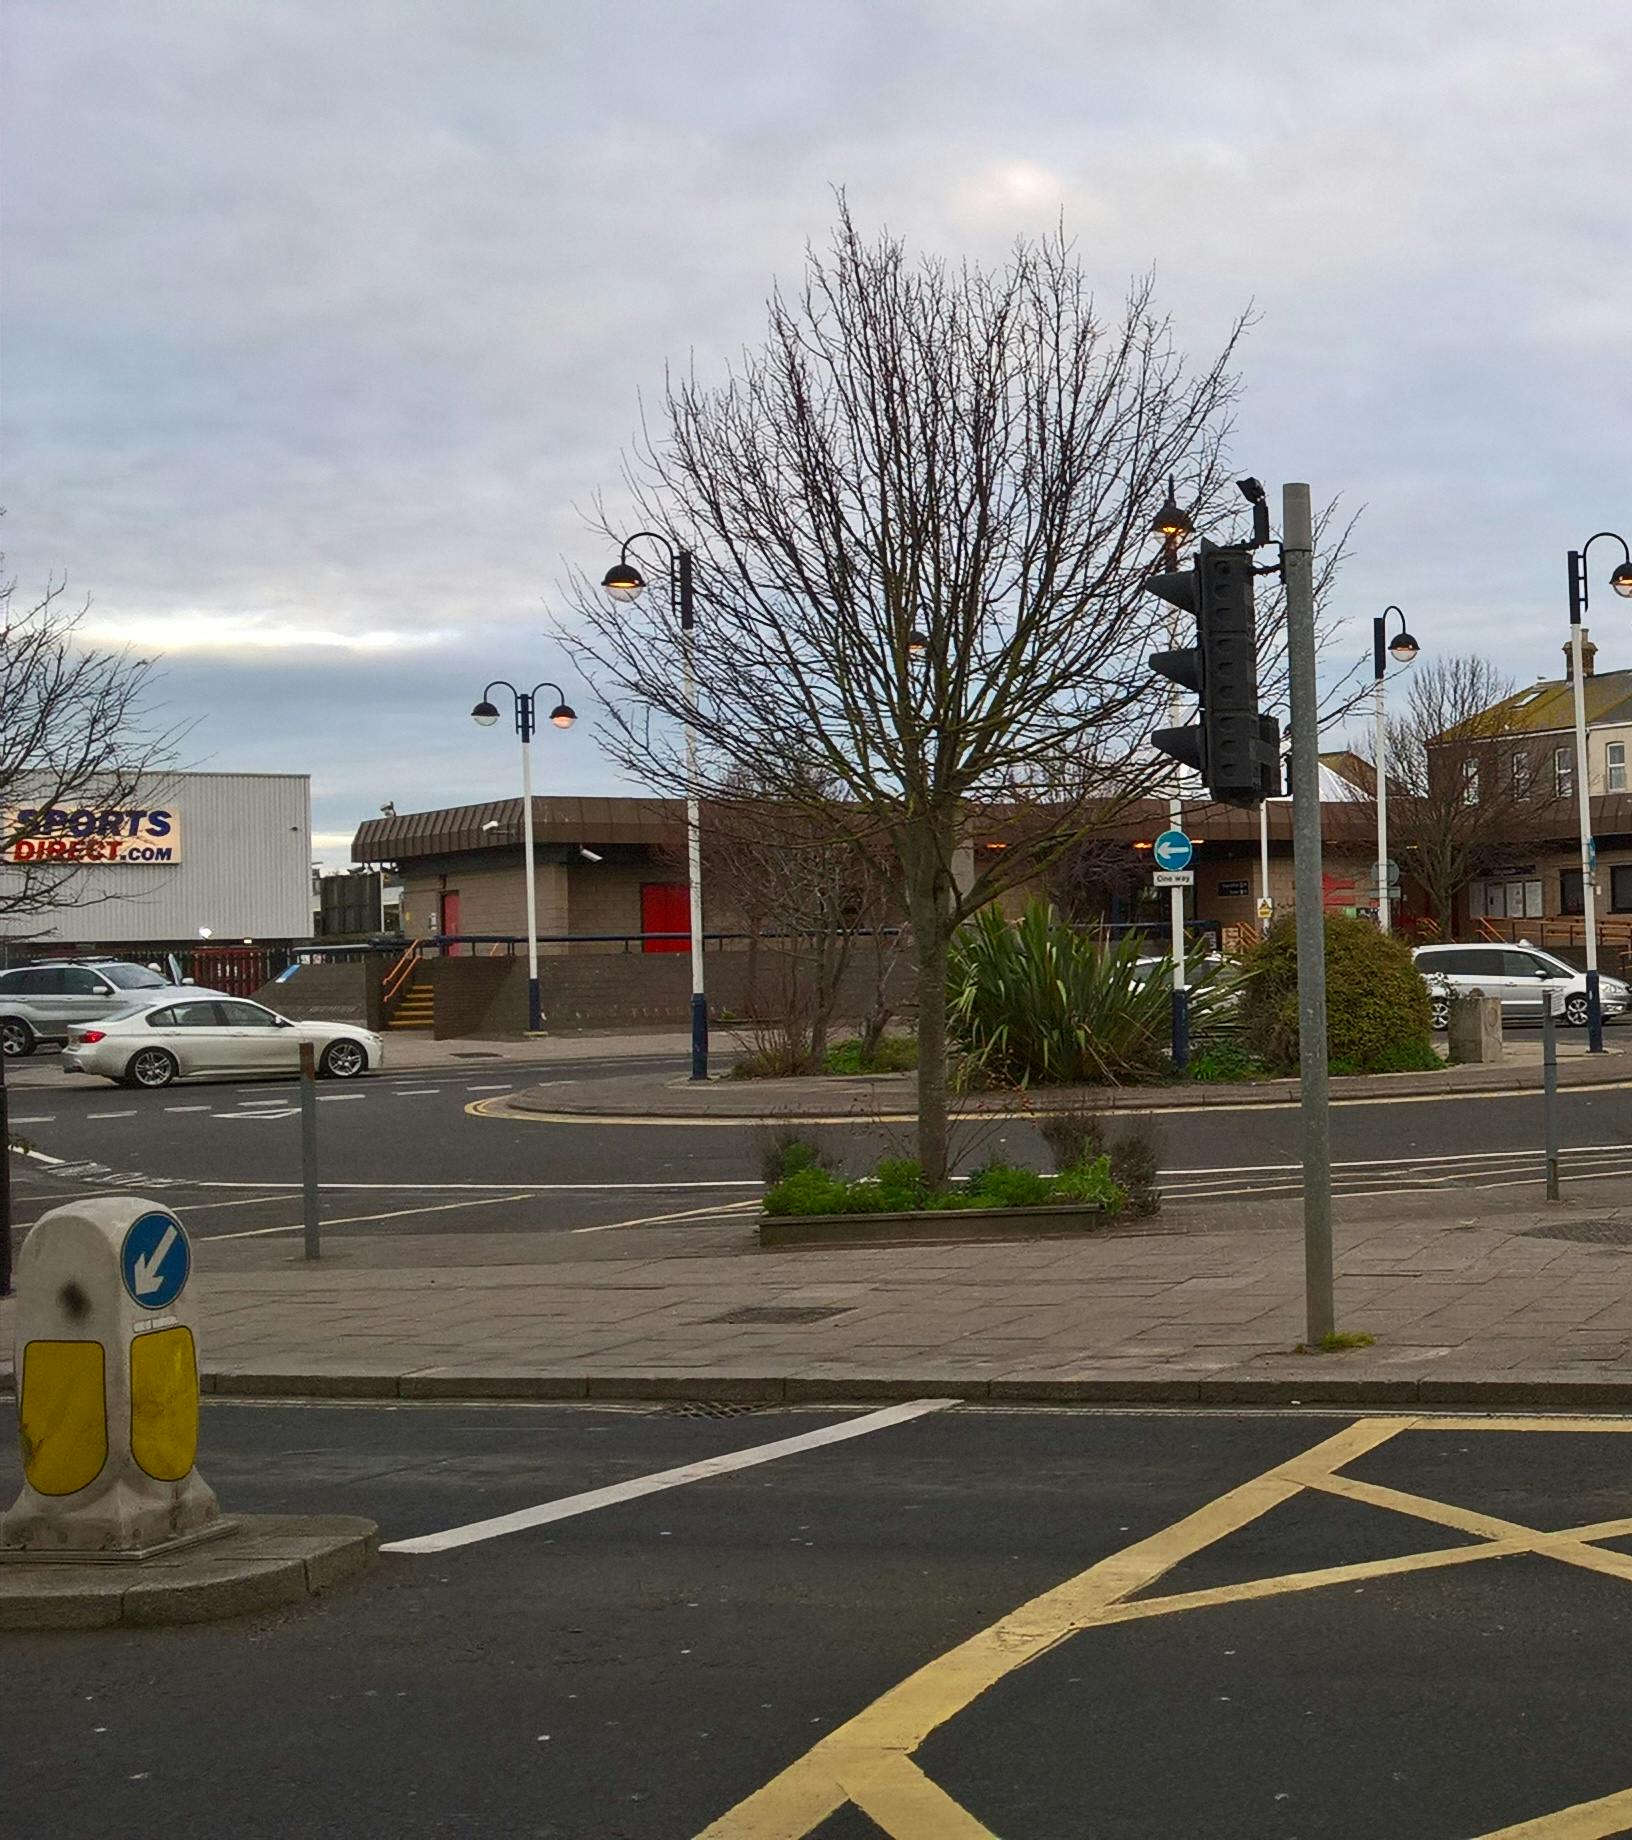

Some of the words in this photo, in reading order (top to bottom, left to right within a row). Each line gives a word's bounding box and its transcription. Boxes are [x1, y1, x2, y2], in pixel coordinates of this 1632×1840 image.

[17, 808, 173, 837] SPORTS
[1156, 874, 1173, 883] One
[1174, 875, 1190, 884] way
